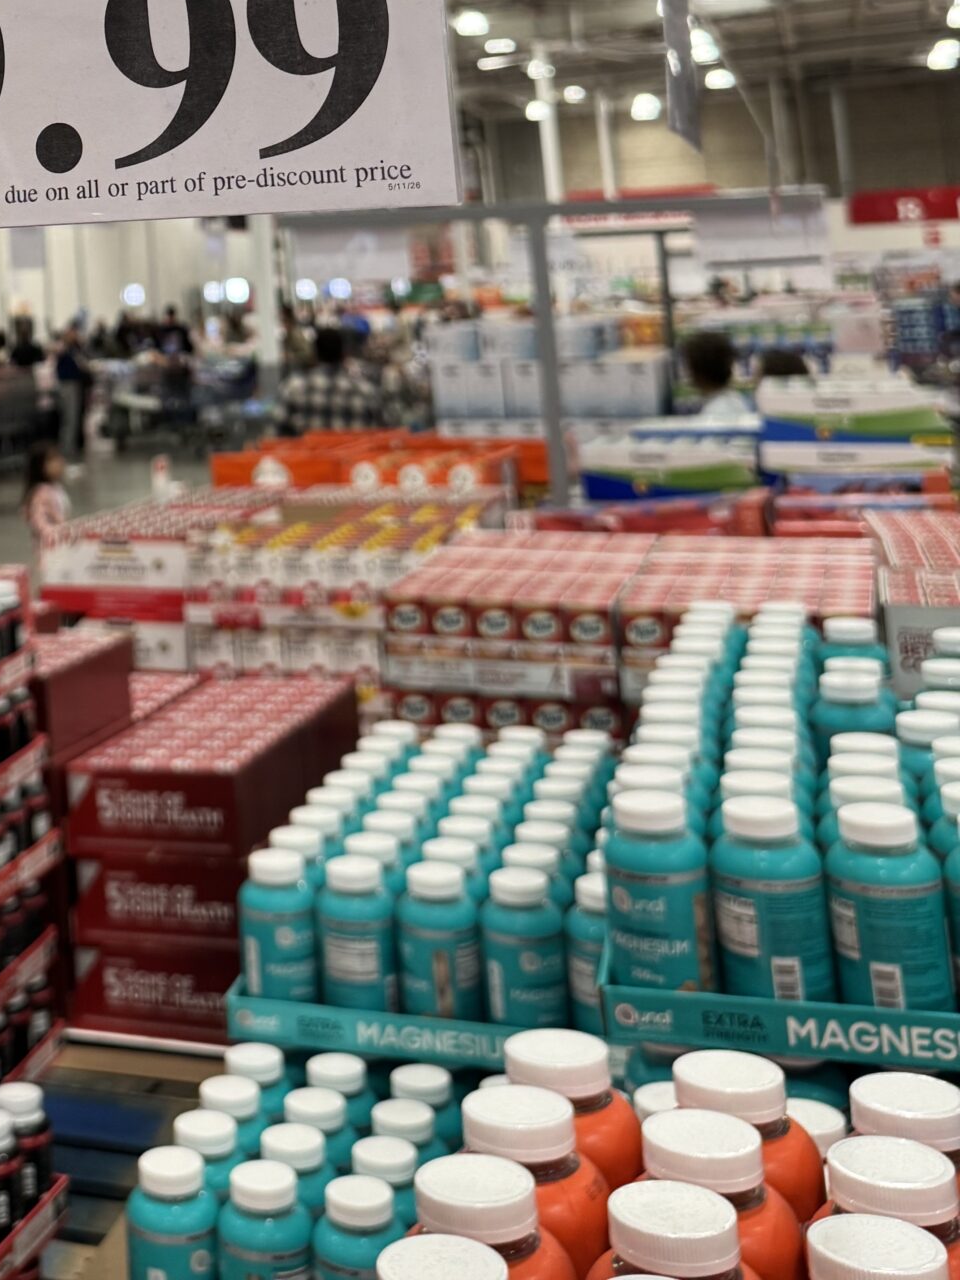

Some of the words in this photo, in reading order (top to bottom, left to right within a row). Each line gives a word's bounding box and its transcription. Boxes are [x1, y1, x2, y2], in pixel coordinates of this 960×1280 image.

[4, 184, 38, 205] due
[45, 186, 70, 202] on
[76, 178, 101, 200] all
[107, 182, 129, 198] or
[135, 176, 177, 201] part
[184, 171, 207, 193] of
[212, 165, 347, 197] pre-discount
[354, 159, 412, 189] price
[355, 1019, 506, 1058] MAGNESIU
[785, 1015, 960, 1062] MAGNES
